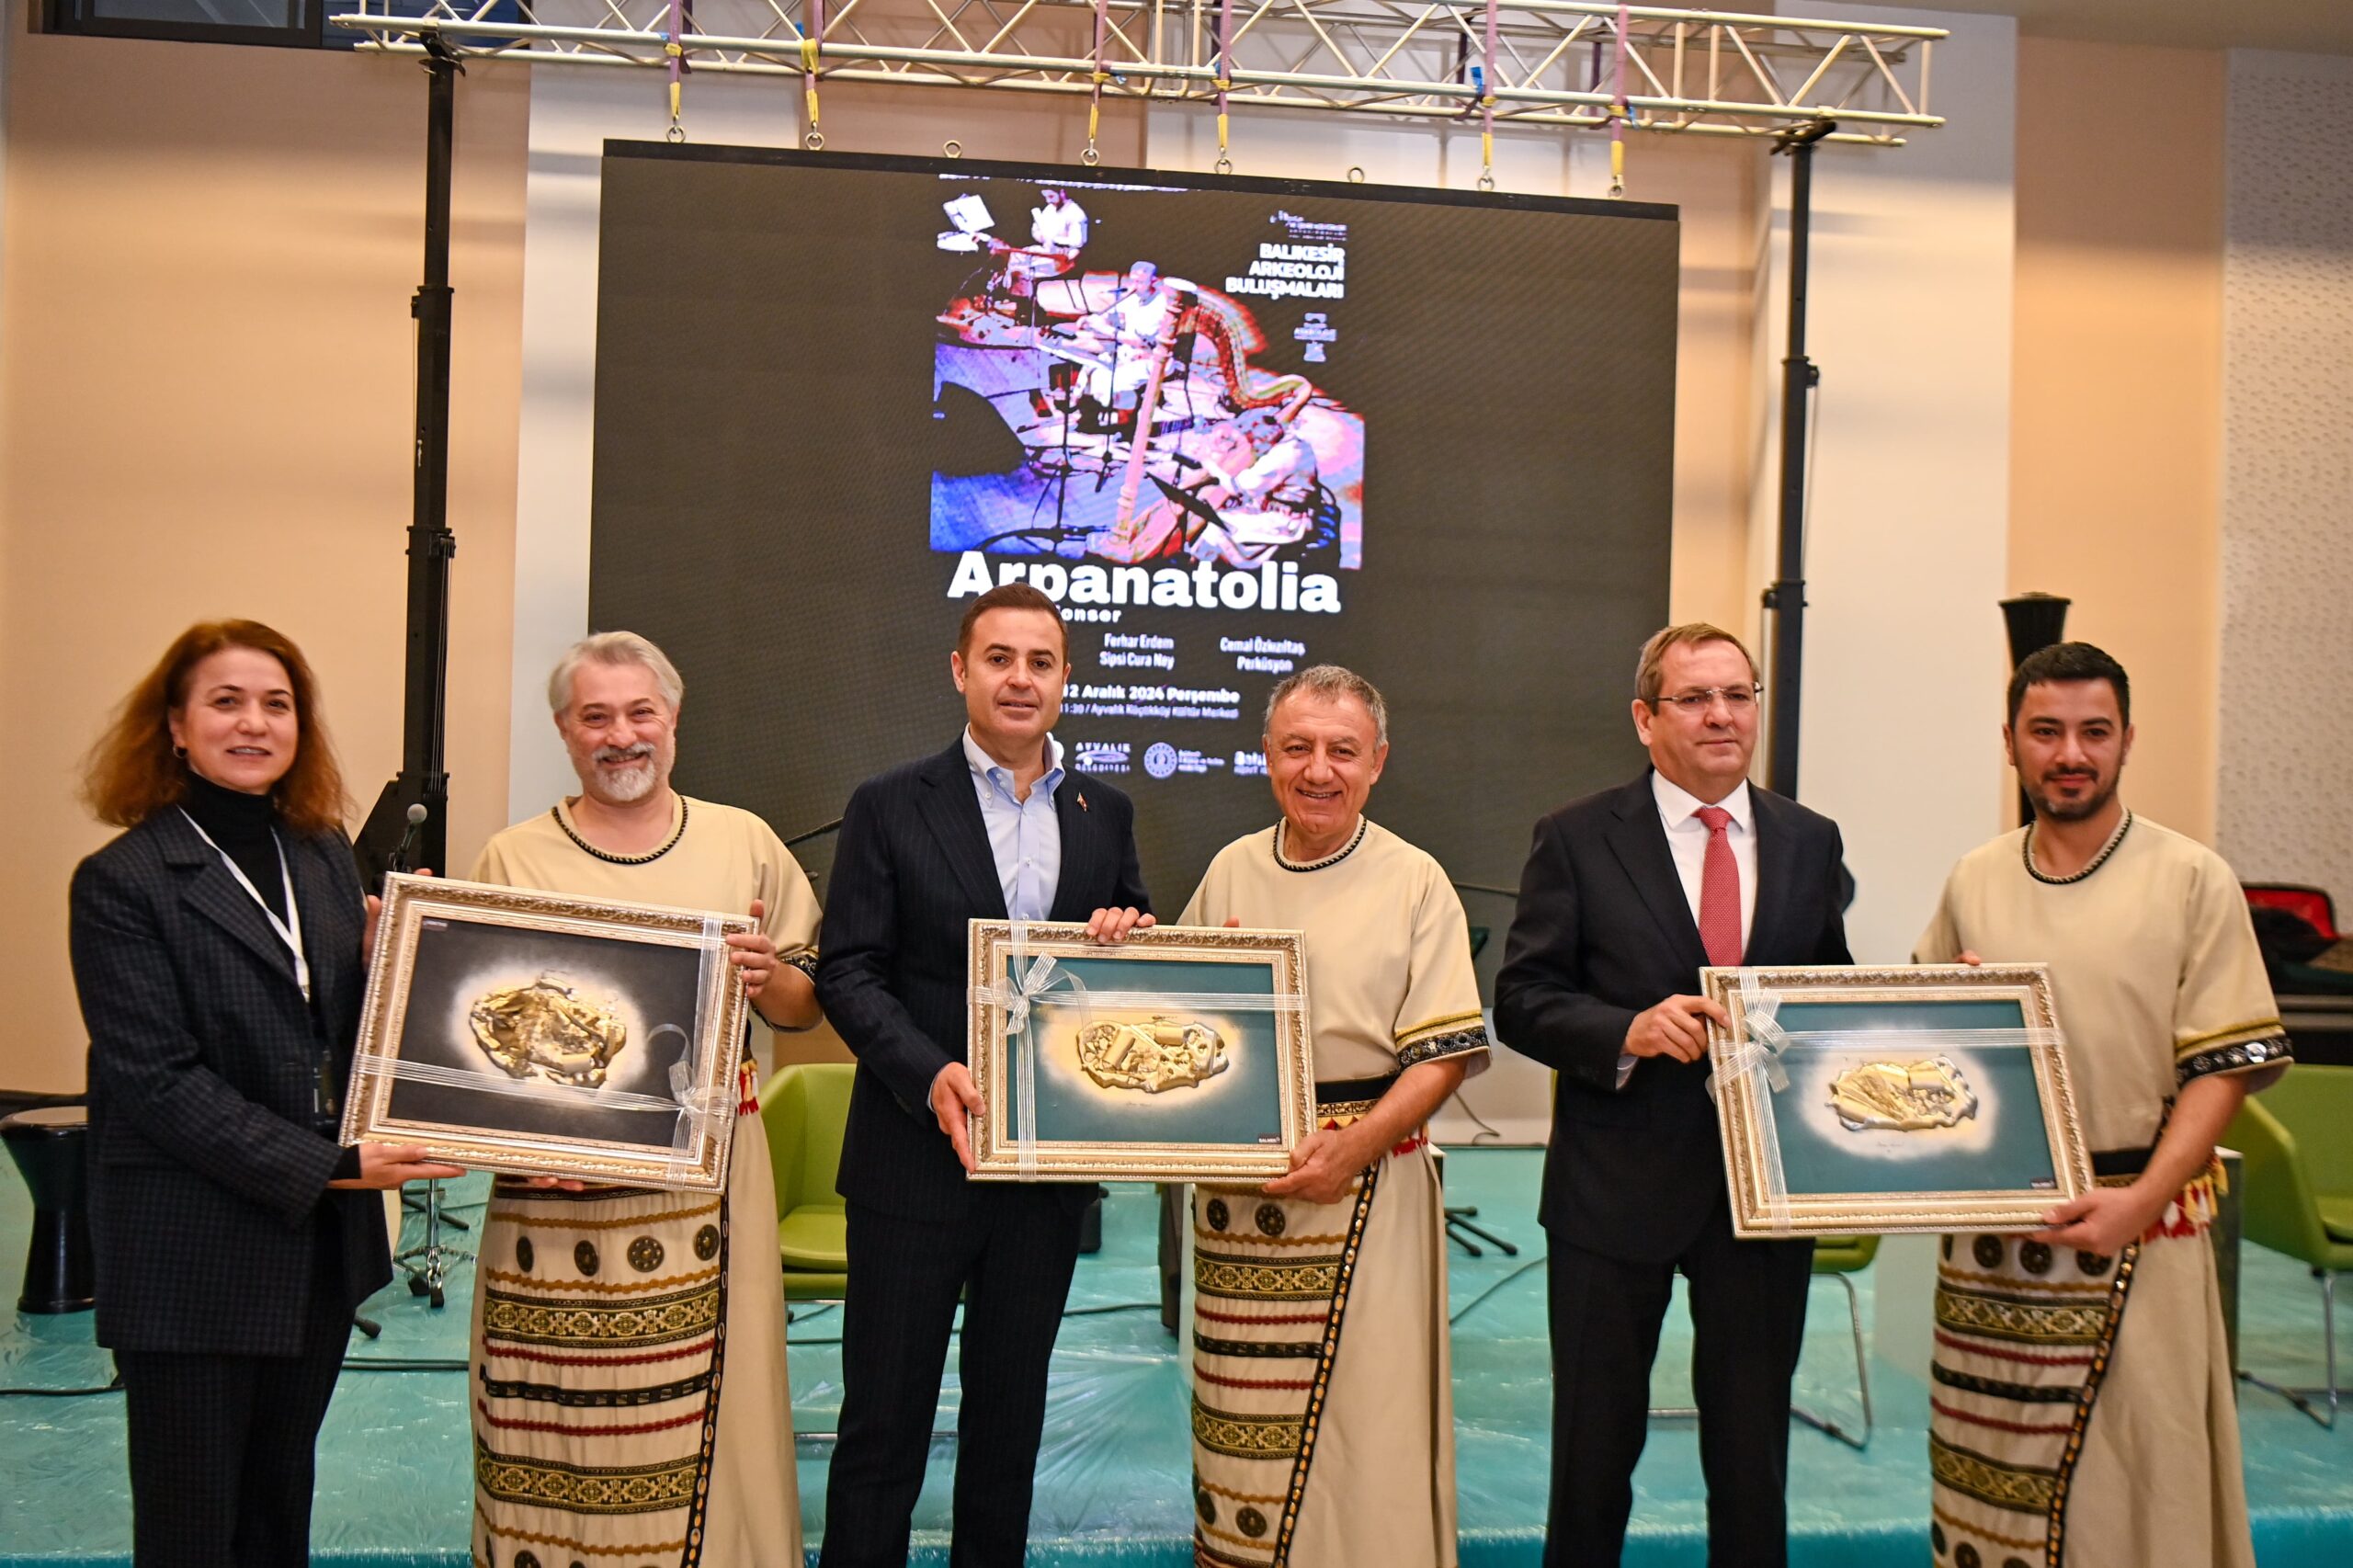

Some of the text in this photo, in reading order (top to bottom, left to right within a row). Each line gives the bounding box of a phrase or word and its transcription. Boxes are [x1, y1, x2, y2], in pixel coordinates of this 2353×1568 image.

[1259, 243, 1346, 264] BALIKESİR
[1225, 277, 1345, 301] BULUŞMALARI
[947, 551, 1341, 613] Arpanatolia
[1055, 605, 1121, 623] onser
[1140, 634, 1175, 649] Erdem
[1220, 636, 1254, 653] Cemal
[1127, 652, 1153, 667] Cura
[1154, 653, 1176, 671] Ney
[1237, 655, 1294, 675] Perküsyon
[1082, 684, 1126, 699] Aralık
[1129, 686, 1165, 701] 2024
[1166, 687, 1241, 705] Perşembe
